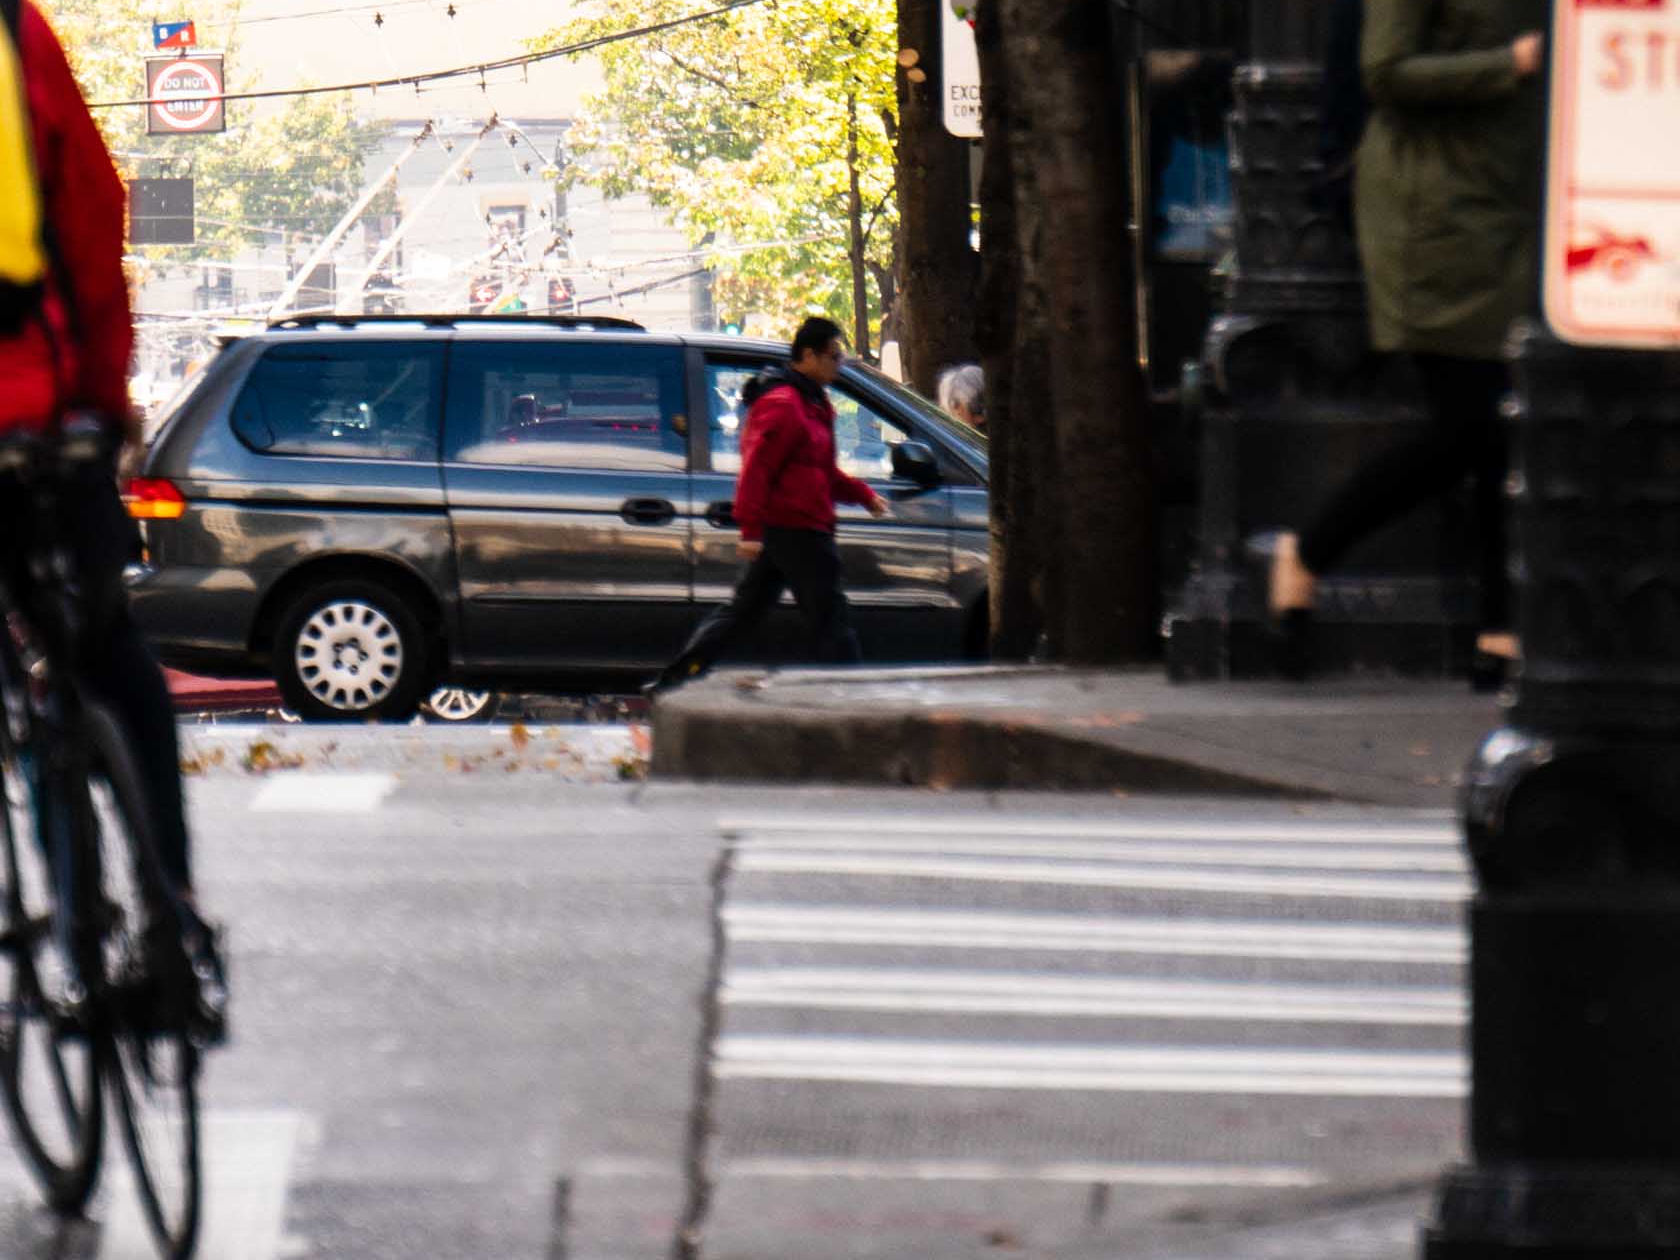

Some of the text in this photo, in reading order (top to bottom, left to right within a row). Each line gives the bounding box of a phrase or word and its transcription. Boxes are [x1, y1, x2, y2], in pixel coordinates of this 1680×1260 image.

[159, 27, 190, 43] B R
[1599, 32, 1680, 92] ST
[164, 76, 206, 89] DO NOT
[951, 85, 982, 100] EXC
[168, 100, 204, 113] ENTER
